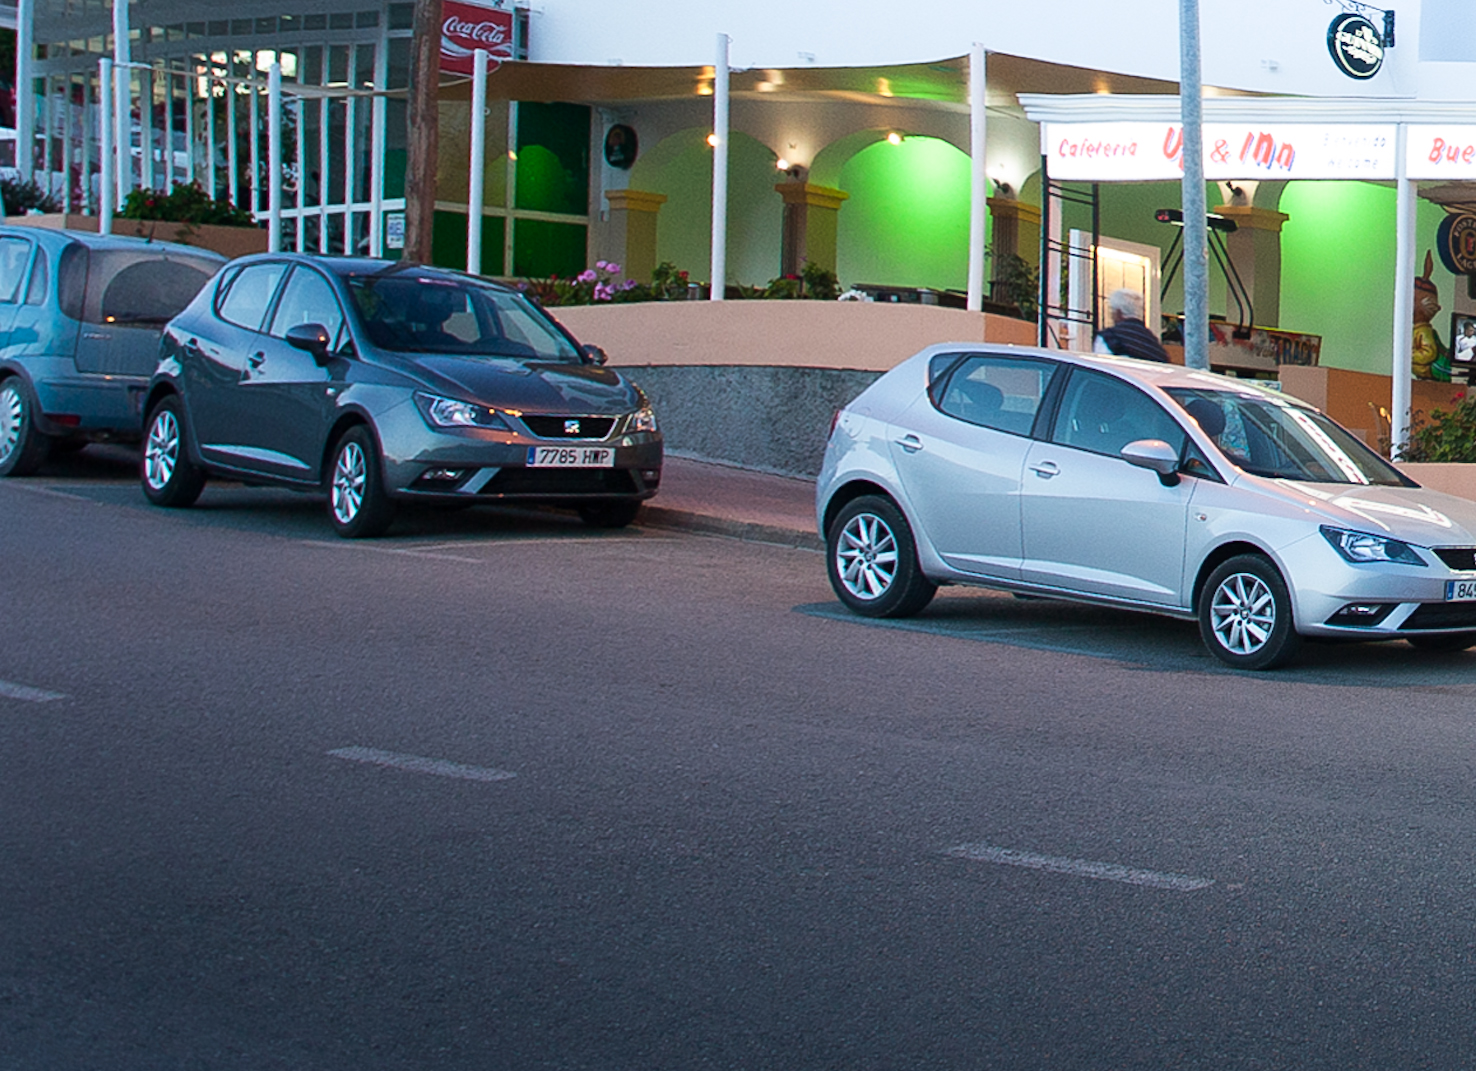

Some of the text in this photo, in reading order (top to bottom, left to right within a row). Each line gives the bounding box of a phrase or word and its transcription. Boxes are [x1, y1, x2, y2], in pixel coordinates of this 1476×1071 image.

[1058, 138, 1138, 159] Cafeteria
[1210, 139, 1230, 164] &
[540, 449, 609, 464] 7785 HWP
